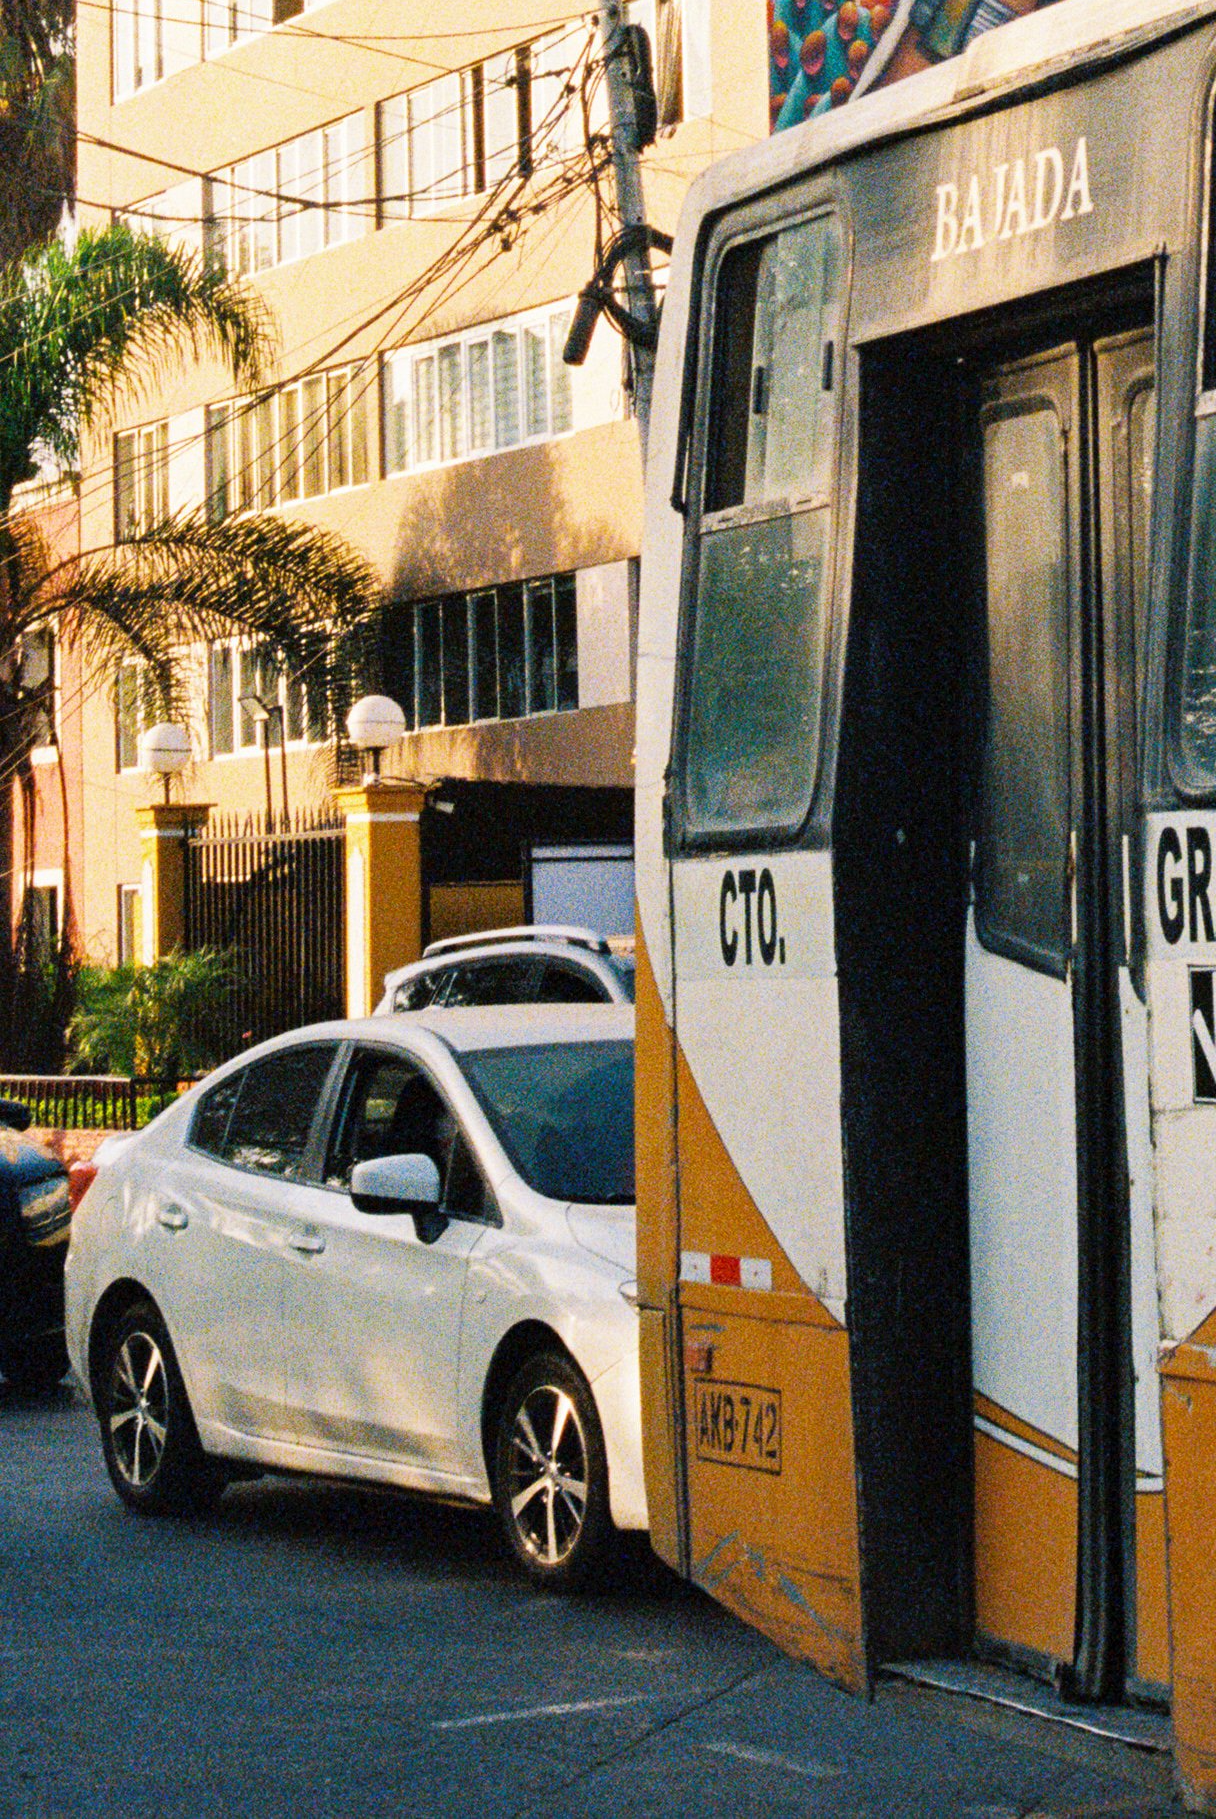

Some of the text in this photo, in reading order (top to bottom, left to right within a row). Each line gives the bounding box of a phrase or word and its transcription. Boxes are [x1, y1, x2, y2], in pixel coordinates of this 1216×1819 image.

[931, 136, 1094, 262] BAJADA
[719, 868, 786, 966] CTO.
[700, 1391, 777, 1458] AKB-742
